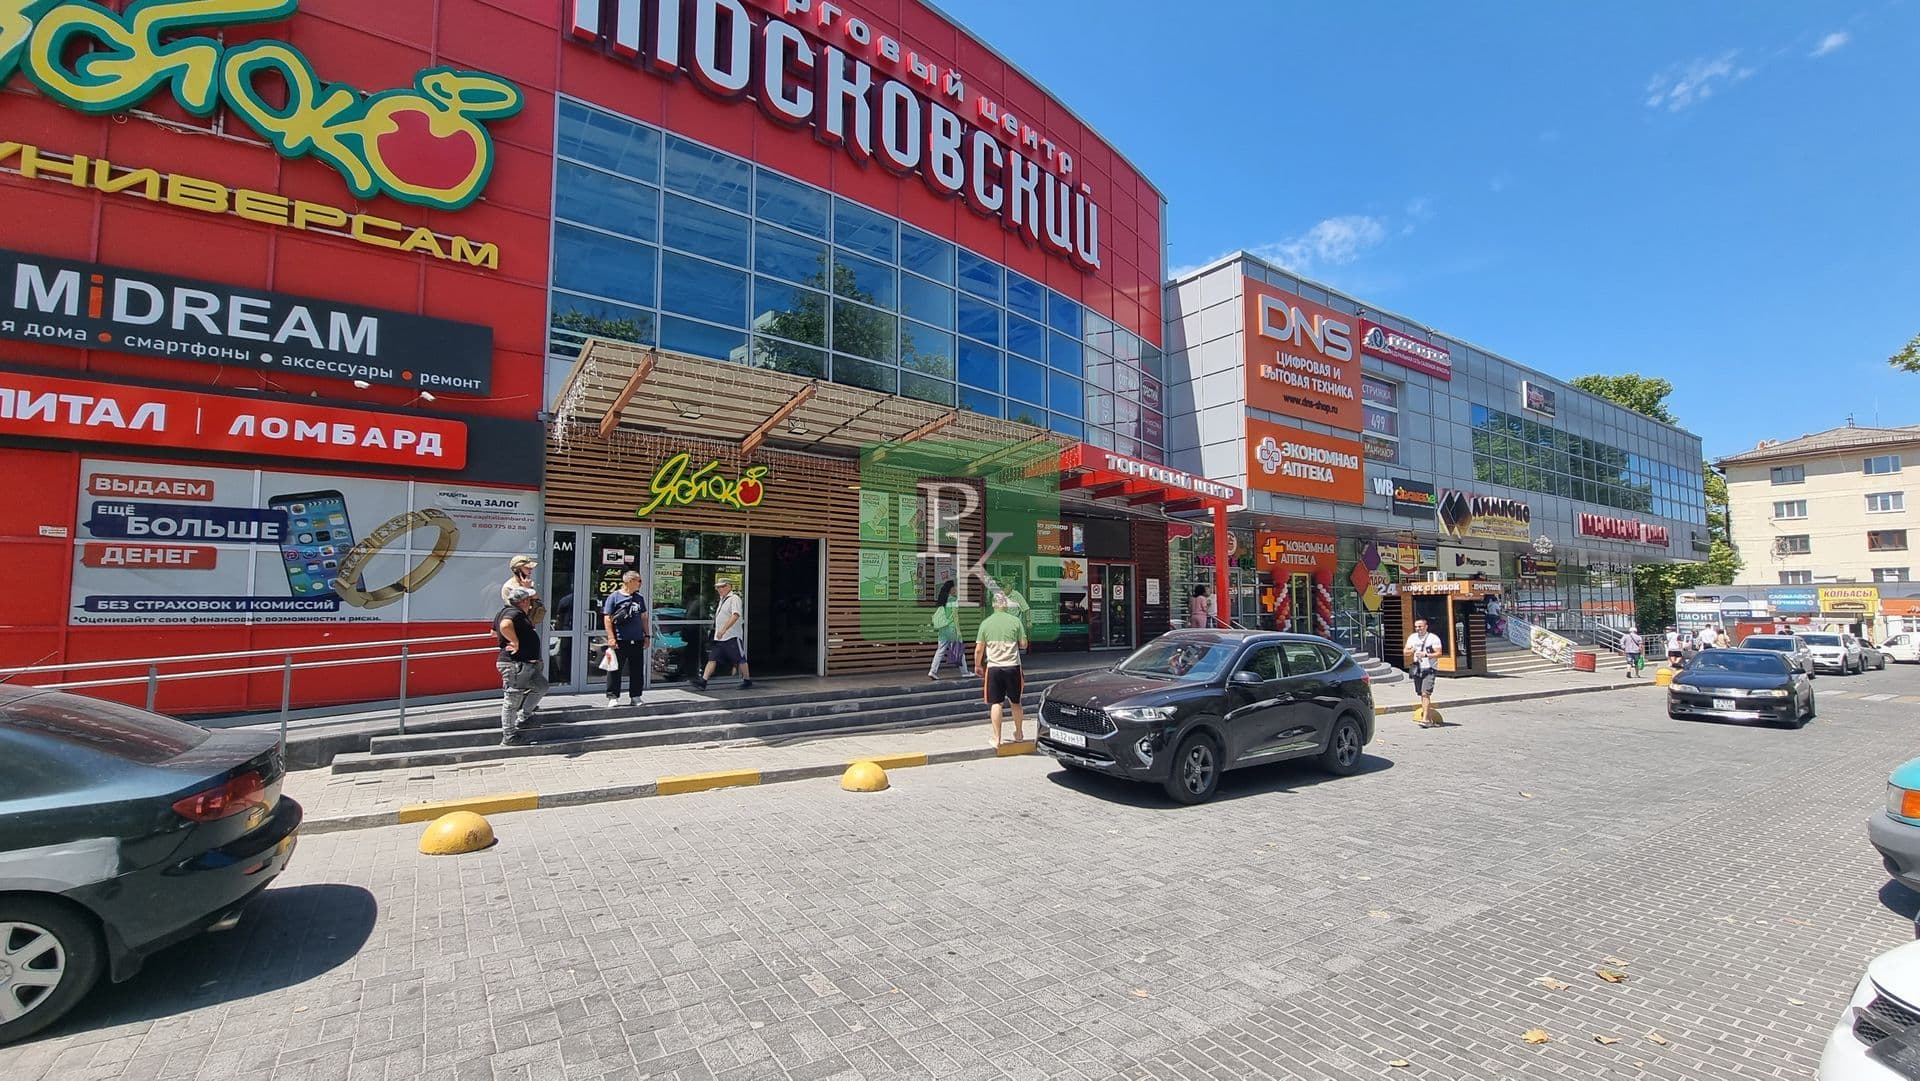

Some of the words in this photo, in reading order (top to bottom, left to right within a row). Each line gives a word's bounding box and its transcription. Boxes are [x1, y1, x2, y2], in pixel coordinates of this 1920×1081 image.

[0, 0, 523, 211] блоко
[1258, 294, 1353, 362] DNS
[24, 322, 87, 341] дома
[124, 335, 250, 361] смартфоны
[281, 352, 393, 381] аксессуары
[419, 370, 482, 390] ремонт
[1277, 351, 1331, 377] ЦИФРОВАЯ
[1333, 367, 1340, 380] И
[1261, 364, 1311, 389] БЫТОВАЯ
[1312, 378, 1354, 400] ТЕХНИКА
[1362, 384, 1391, 400] СТРИЖКА
[1283, 394, 1339, 414] www.dns-shop.ru
[1371, 413, 1386, 430] 499
[228, 414, 443, 457] ЛОМБАРД
[1281, 441, 1359, 471] ЭКОНОМНАЯ
[1105, 454, 1192, 489] ТОРГОВЫЙ
[1194, 479, 1233, 499] ЦЕНТР
[1281, 461, 1335, 483] АПТЕКА
[95, 477, 207, 497] ВЫДАЕМ
[1373, 478, 1394, 496] WB
[97, 504, 135, 517] ЕЩЁ
[461, 499, 481, 507] под
[484, 499, 520, 508] ЗАЛОГ
[126, 516, 280, 540] БОЛЬШЕ
[101, 545, 198, 567] ДЕНЕГ
[1281, 553, 1316, 565] АПТЕКА
[1378, 584, 1396, 595] 24
[97, 600, 129, 611] БЕЗ
[133, 600, 231, 611] СТРАХОВОК
[235, 600, 246, 611] И
[251, 599, 334, 611] КОМИССИЙ
